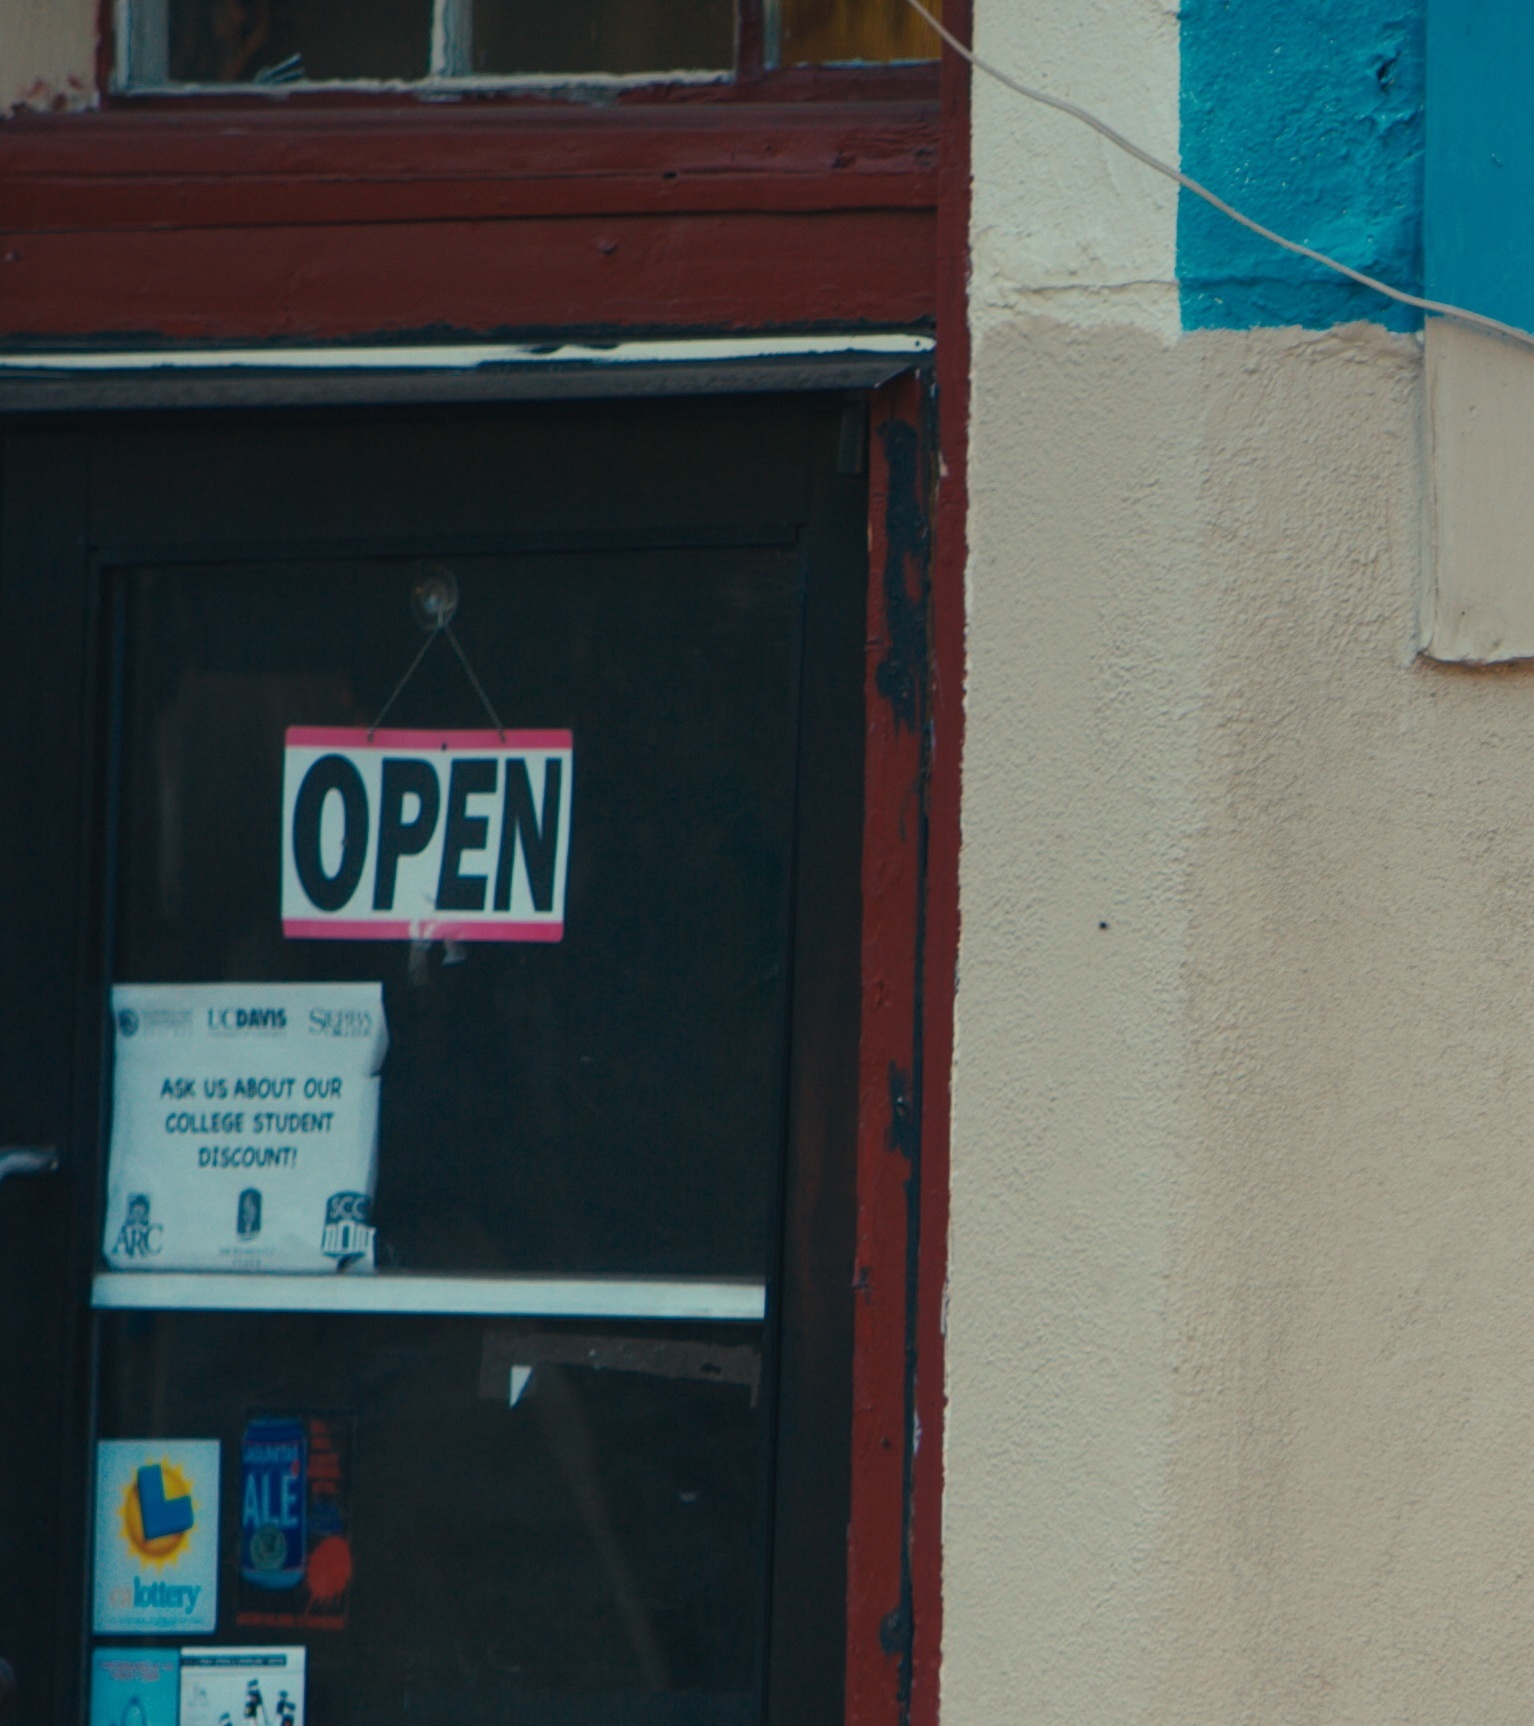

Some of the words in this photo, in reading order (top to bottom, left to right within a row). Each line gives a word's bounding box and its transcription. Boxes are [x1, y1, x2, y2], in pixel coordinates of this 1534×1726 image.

[292, 754, 563, 913] OPEN
[161, 1078, 195, 1098] ASK
[204, 1078, 228, 1098] US
[234, 1078, 295, 1099] ABOUT
[304, 1078, 342, 1098] OUR
[165, 1112, 244, 1133] COLLEGE
[253, 1112, 334, 1133] STUDENT
[198, 1146, 298, 1169] DISCOUNT!
[331, 1196, 370, 1221] SCC
[112, 1223, 164, 1259] ARC
[242, 1473, 299, 1528] ALE
